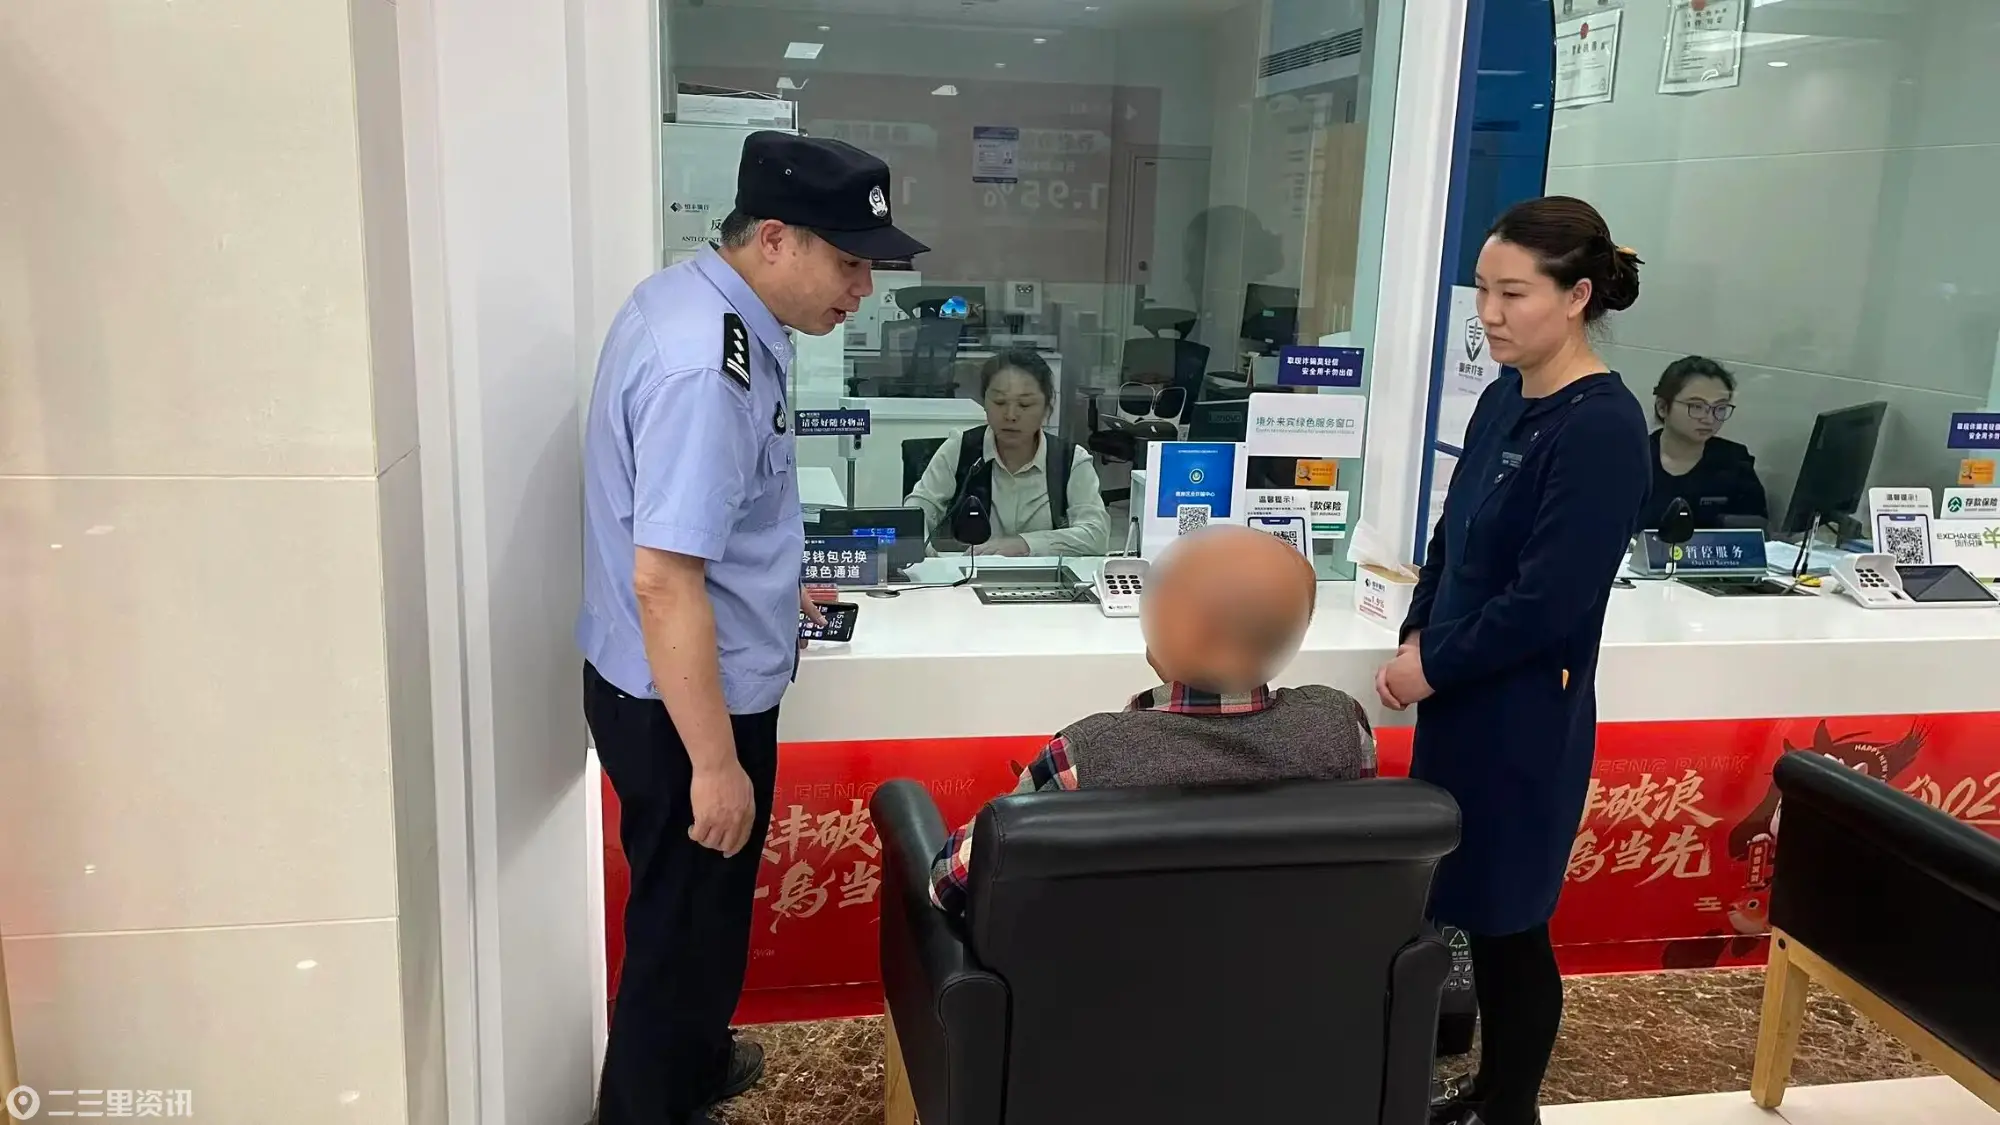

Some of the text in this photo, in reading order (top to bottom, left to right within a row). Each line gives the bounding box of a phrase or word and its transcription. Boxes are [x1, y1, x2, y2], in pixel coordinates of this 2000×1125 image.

[1256, 416, 1355, 428] 境外来宾绿色服务窗口
[802, 550, 867, 563] 零钱包兑换
[1685, 545, 1743, 559] 暂停服务
[805, 565, 860, 578] 绿色通道
